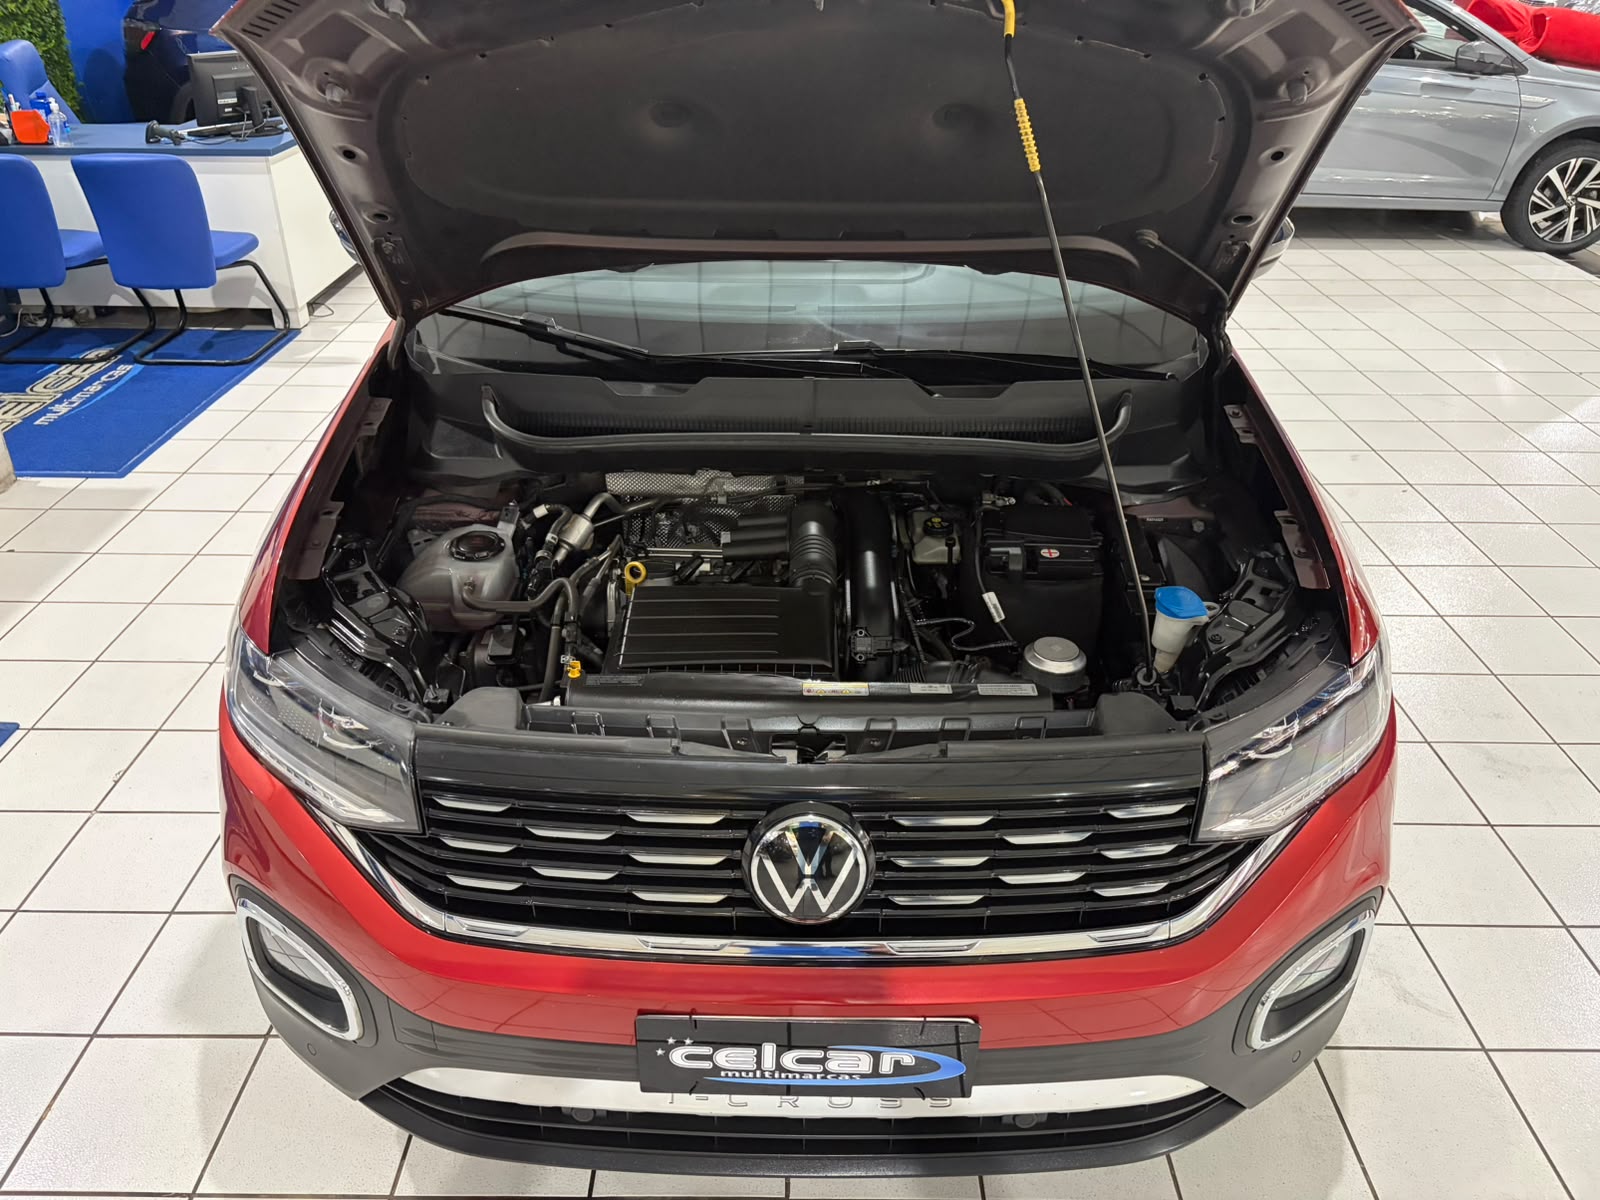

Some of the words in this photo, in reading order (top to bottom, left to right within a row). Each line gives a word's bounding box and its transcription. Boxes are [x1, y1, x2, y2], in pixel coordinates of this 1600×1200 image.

[0, 347, 123, 433] elcar
[33, 363, 134, 425] multimarcas
[757, 828, 860, 913] VW
[668, 1042, 915, 1074] celcar
[720, 1068, 862, 1081] multimarcas
